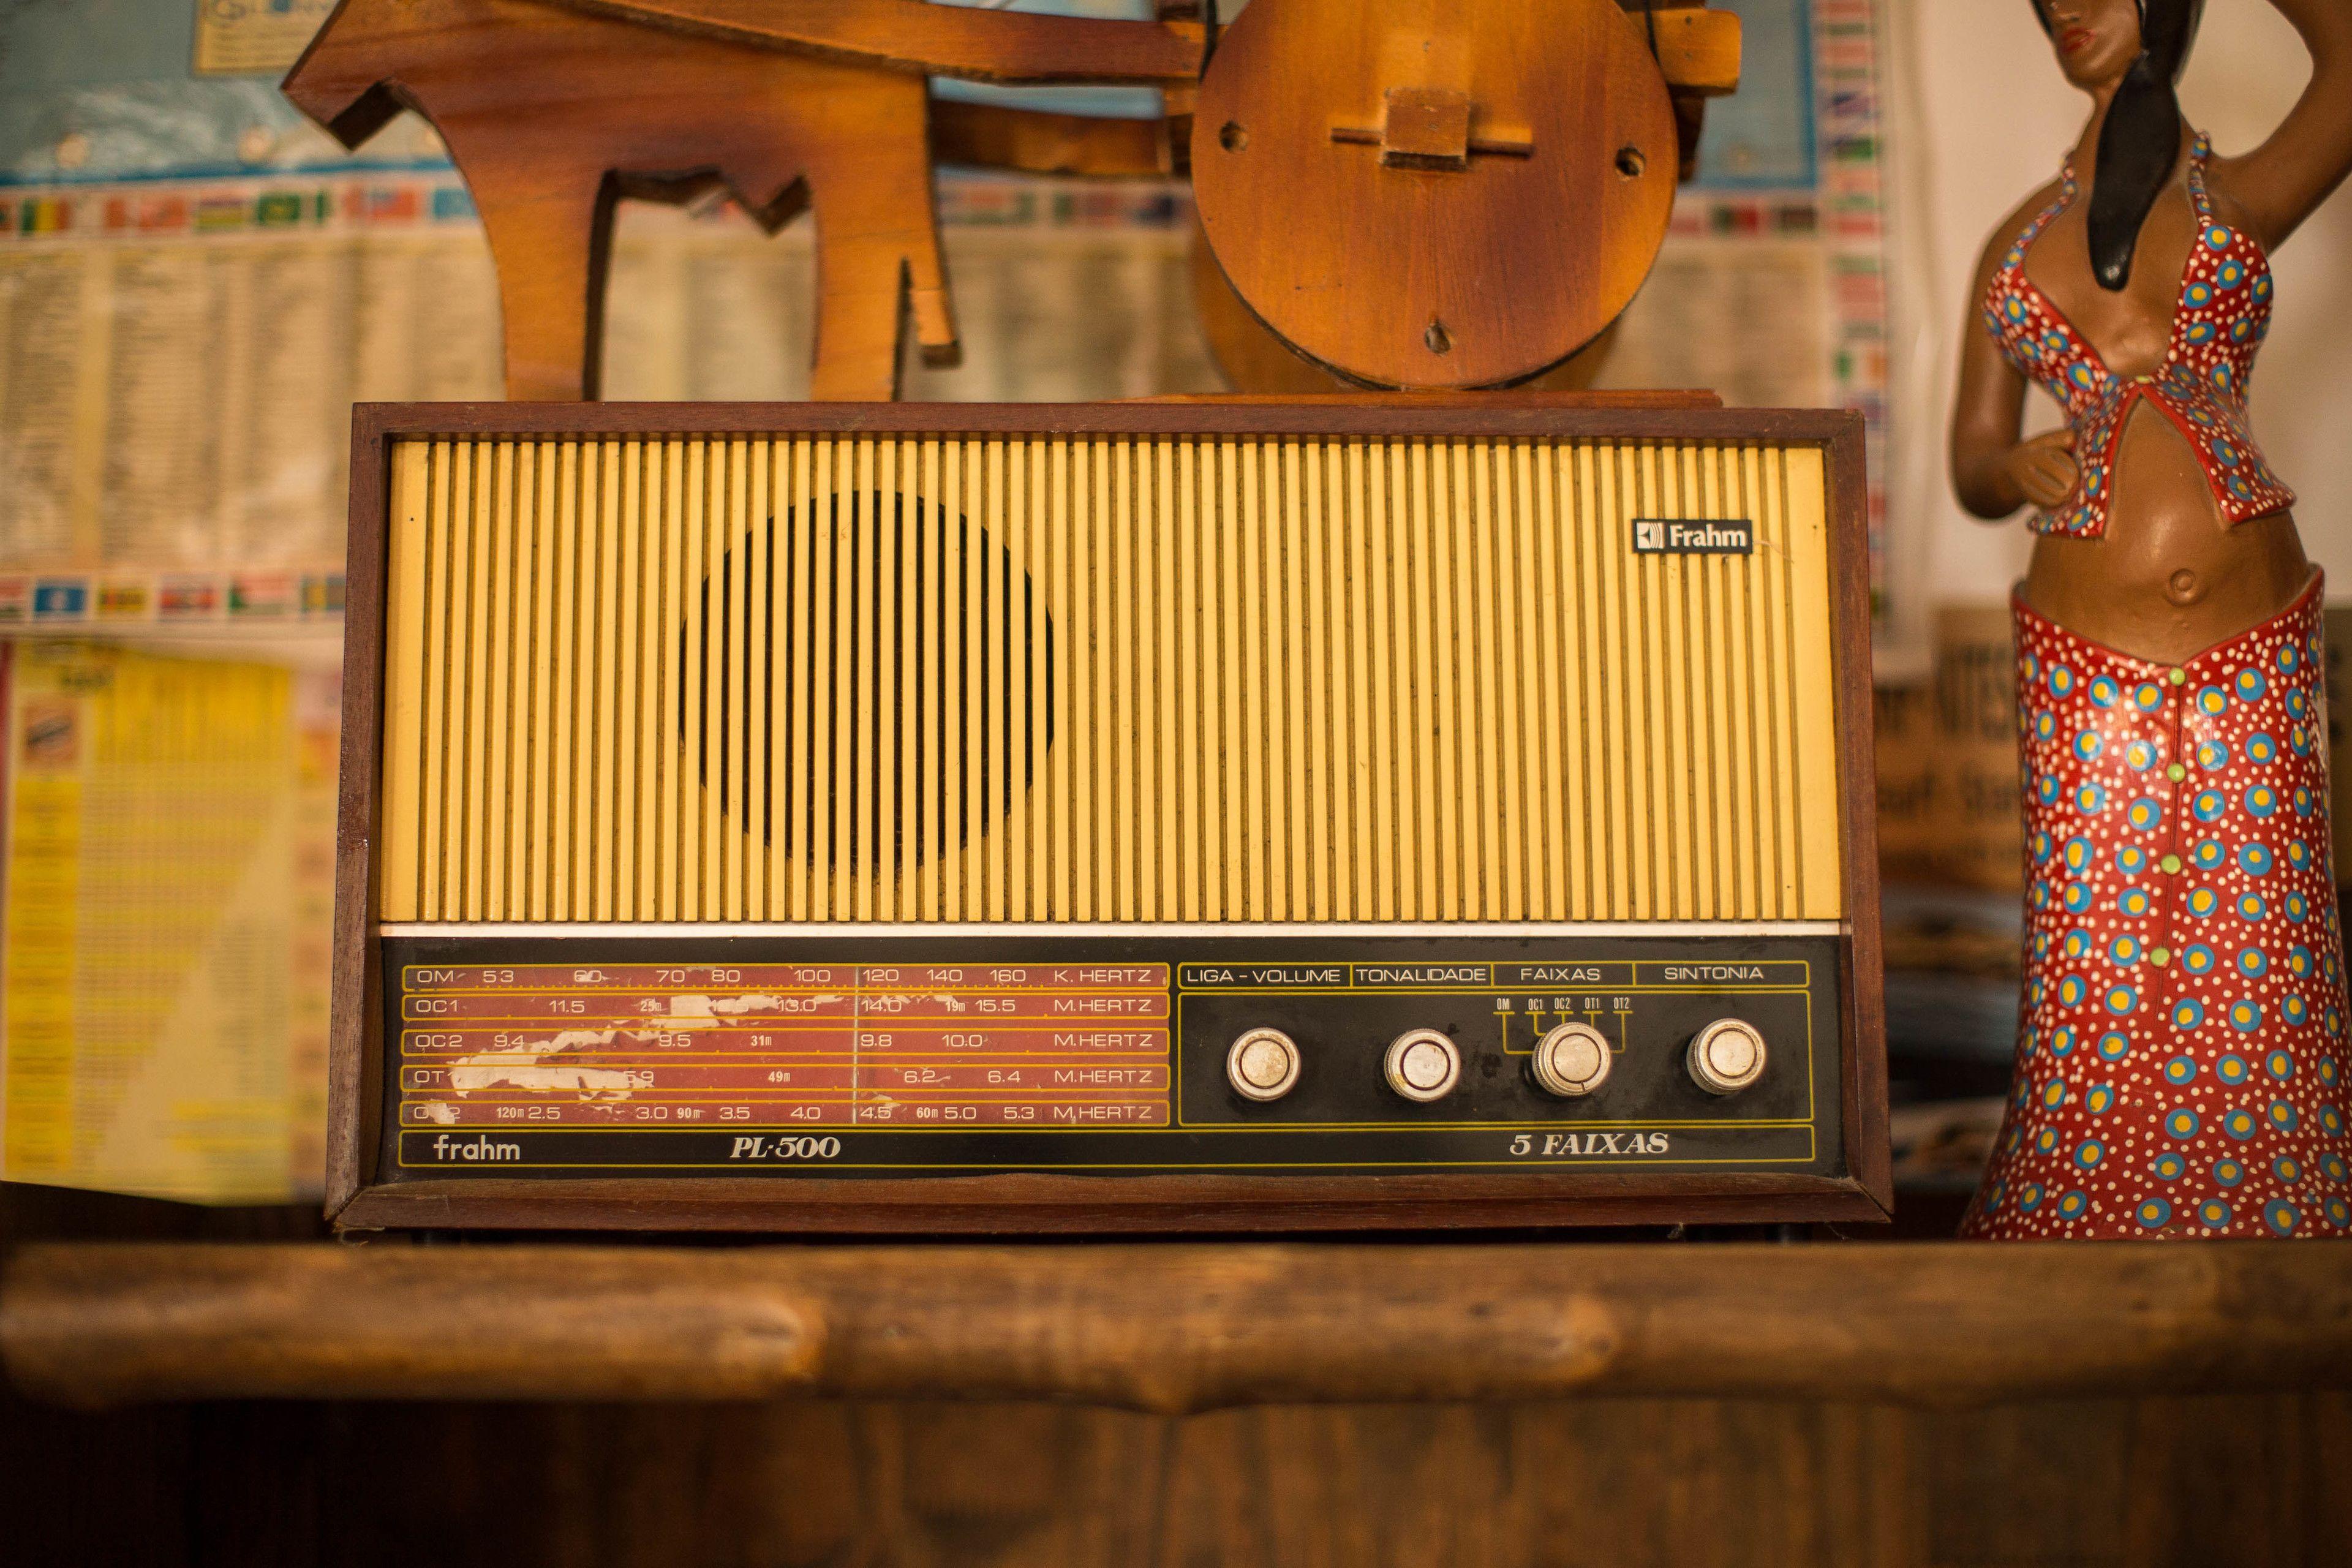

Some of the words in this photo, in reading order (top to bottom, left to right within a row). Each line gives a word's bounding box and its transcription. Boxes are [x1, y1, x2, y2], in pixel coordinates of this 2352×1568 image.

[1670, 524, 1746, 547] Frahm
[417, 970, 454, 982] OM
[483, 970, 514, 982] 53
[657, 970, 685, 982] 70
[712, 970, 741, 982] 80
[794, 970, 831, 982] 100
[863, 970, 899, 982] 120
[927, 970, 963, 982] 140
[990, 970, 1026, 982] 160
[1187, 970, 1234, 982] LIGA
[1253, 970, 1340, 982] VOLUME
[1355, 968, 1487, 982] TONALIDADE
[1521, 968, 1600, 981] FAIXAS
[1664, 966, 1765, 980] SINTONIA
[415, 1000, 458, 1013] OC1
[549, 1000, 585, 1013] 11.5
[861, 1000, 902, 1012] 14.0
[946, 1000, 965, 1012] 19m
[975, 1000, 1016, 1012] 15.5
[1496, 998, 1510, 1010] OM
[1528, 998, 1544, 1011] OC1
[1554, 997, 1570, 1009] OC2
[1585, 997, 1599, 1009] OT1
[1613, 997, 1630, 1009] OT2
[415, 1035, 463, 1048] OC2
[494, 1035, 524, 1047] 9.4
[659, 1035, 692, 1047] 9.5
[751, 1035, 772, 1047] 31m
[861, 1035, 892, 1047] 9.8
[941, 1035, 983, 1047] 10.0
[769, 1071, 791, 1083] 49m
[904, 1070, 935, 1083] 6.2
[988, 1070, 1021, 1083] 6.4
[413, 1107, 461, 1119] O2
[496, 1107, 524, 1118] 120m
[528, 1107, 560, 1119] 2.5
[636, 1106, 668, 1119] 3.0
[677, 1107, 700, 1119] 90m
[720, 1107, 750, 1119] 3.5
[791, 1107, 821, 1119] 4.0
[860, 1106, 891, 1119] 4.5
[916, 1107, 938, 1118] 60m
[944, 1106, 976, 1119] 5.0
[1004, 1106, 1035, 1119] 5.3
[434, 1134, 520, 1160] frahm
[1510, 1135, 1531, 1156] 5
[1541, 1133, 1668, 1155] FAIXAS
